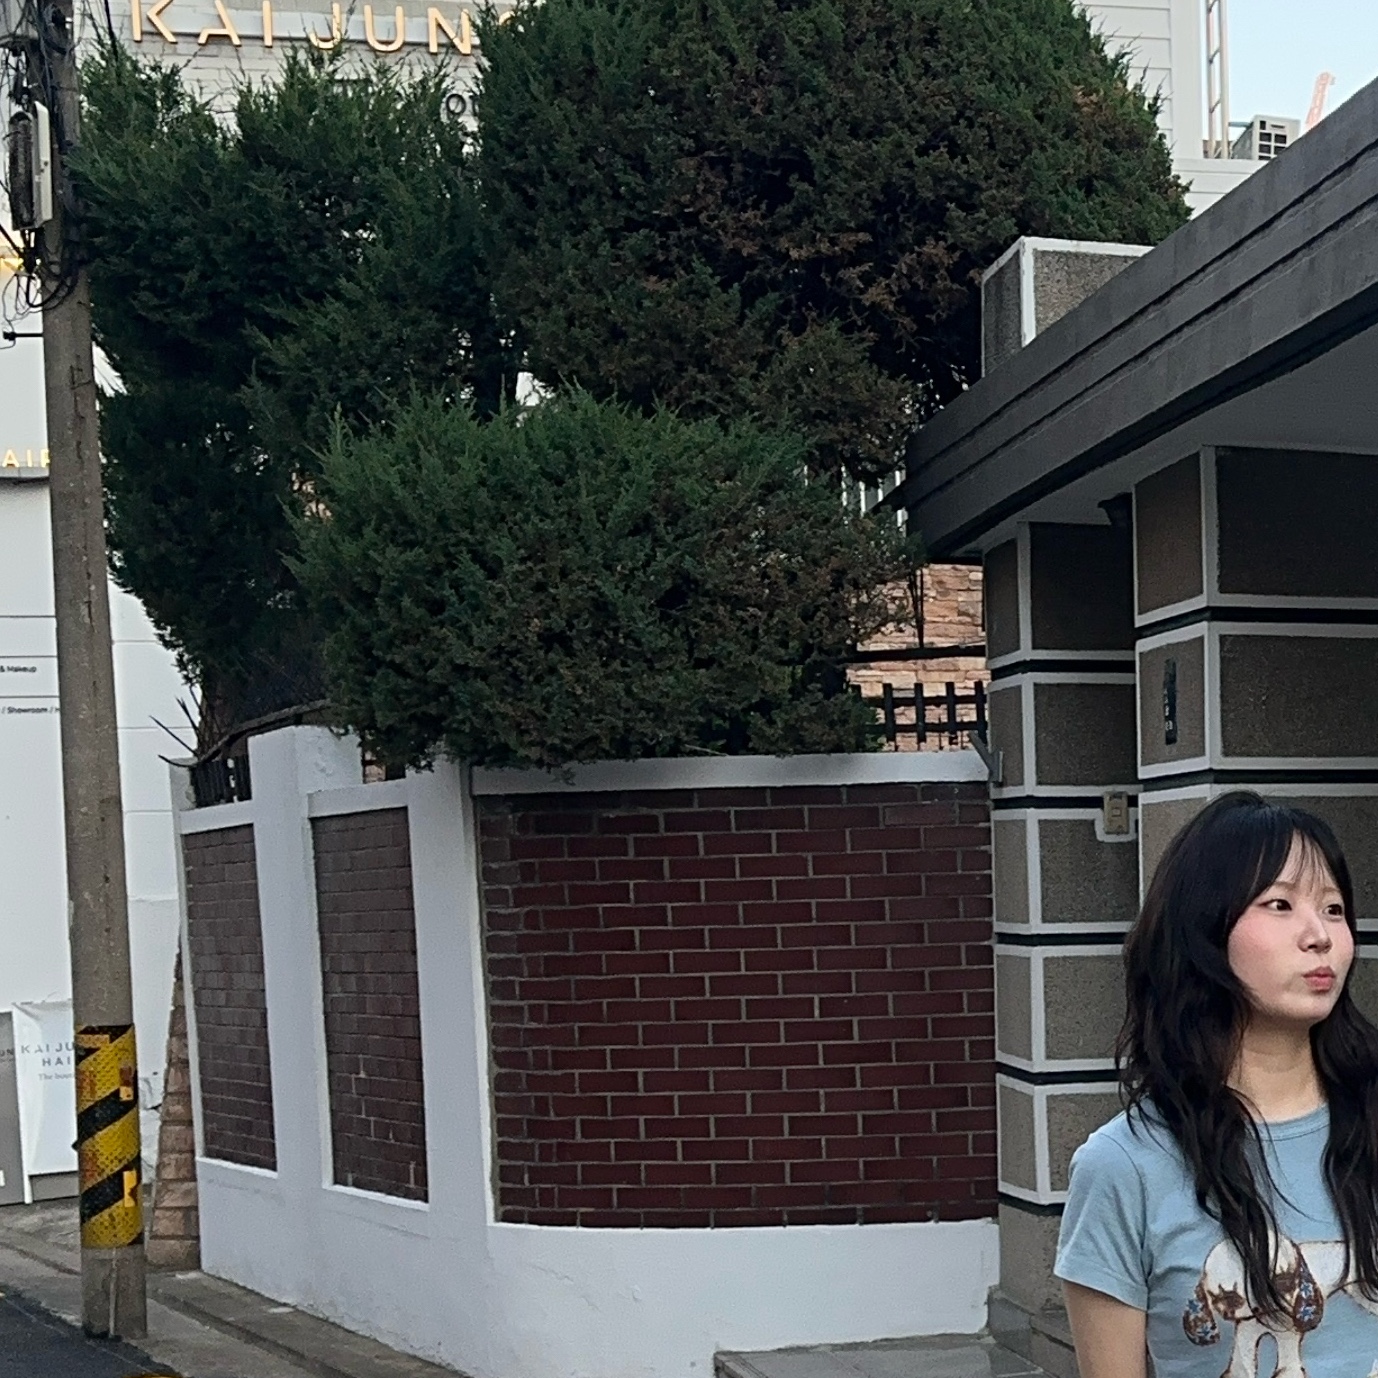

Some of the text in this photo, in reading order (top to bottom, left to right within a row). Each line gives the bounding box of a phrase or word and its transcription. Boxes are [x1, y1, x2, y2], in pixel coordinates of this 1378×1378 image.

[131, 0, 515, 54] KAI JUN
[7, 706, 48, 714] Showroom
